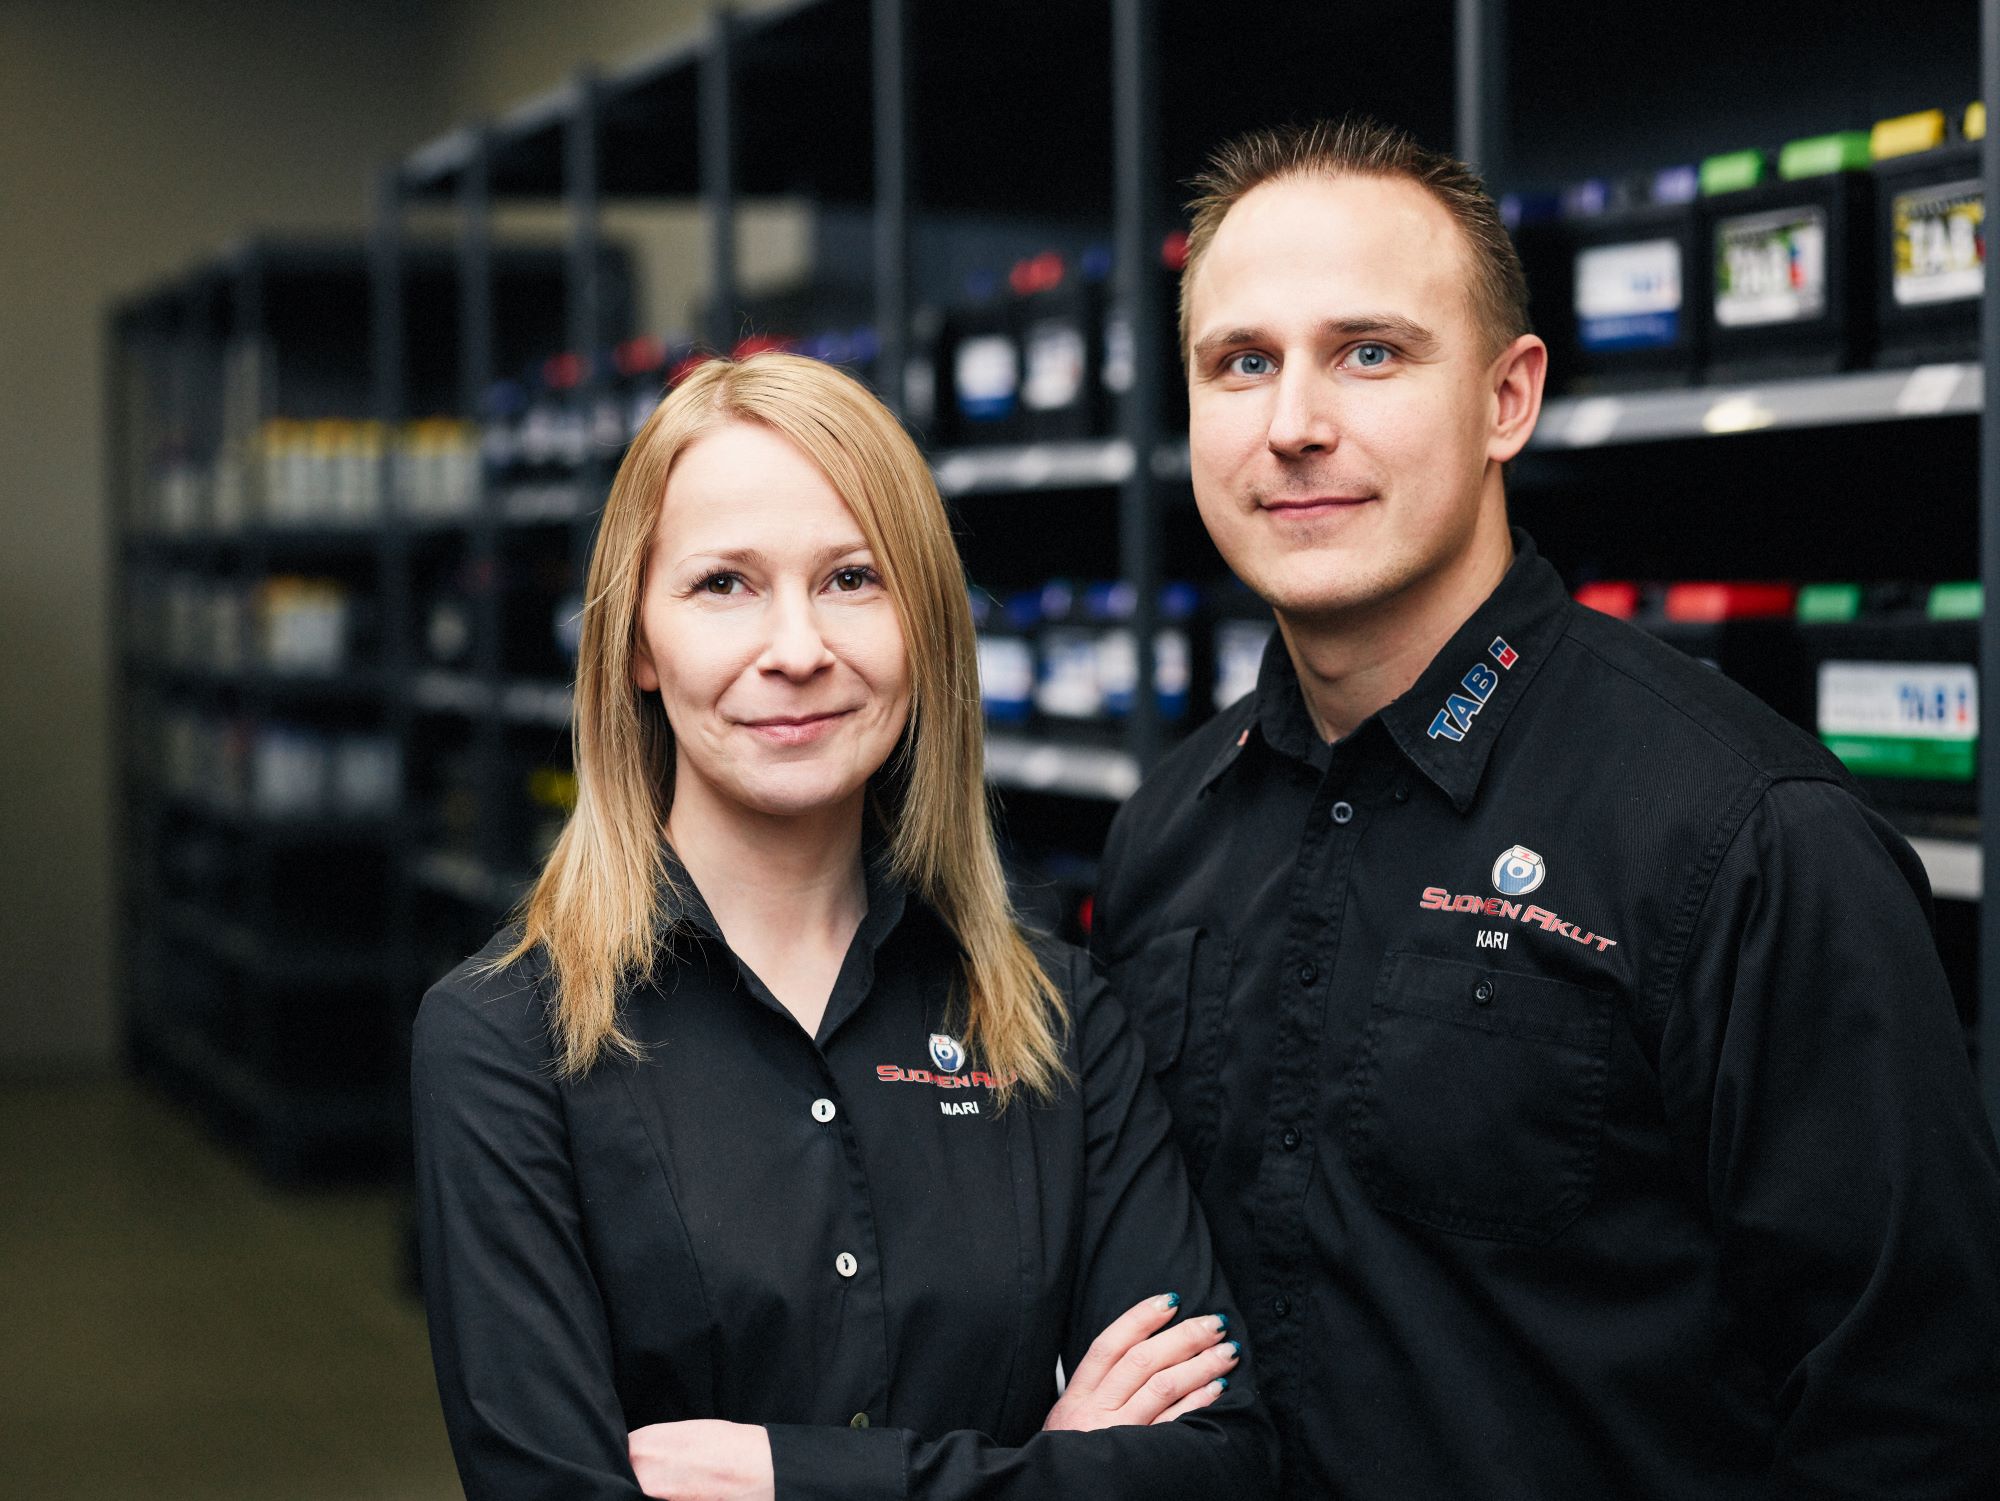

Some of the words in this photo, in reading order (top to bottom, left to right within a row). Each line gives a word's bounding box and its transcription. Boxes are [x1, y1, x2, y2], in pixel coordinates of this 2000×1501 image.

[1427, 662, 1498, 741] TAB
[1420, 887, 1523, 920] SUOMEN
[1521, 904, 1617, 952] AKUT
[1476, 930, 1509, 950] KARI
[940, 1101, 980, 1116] MARI
